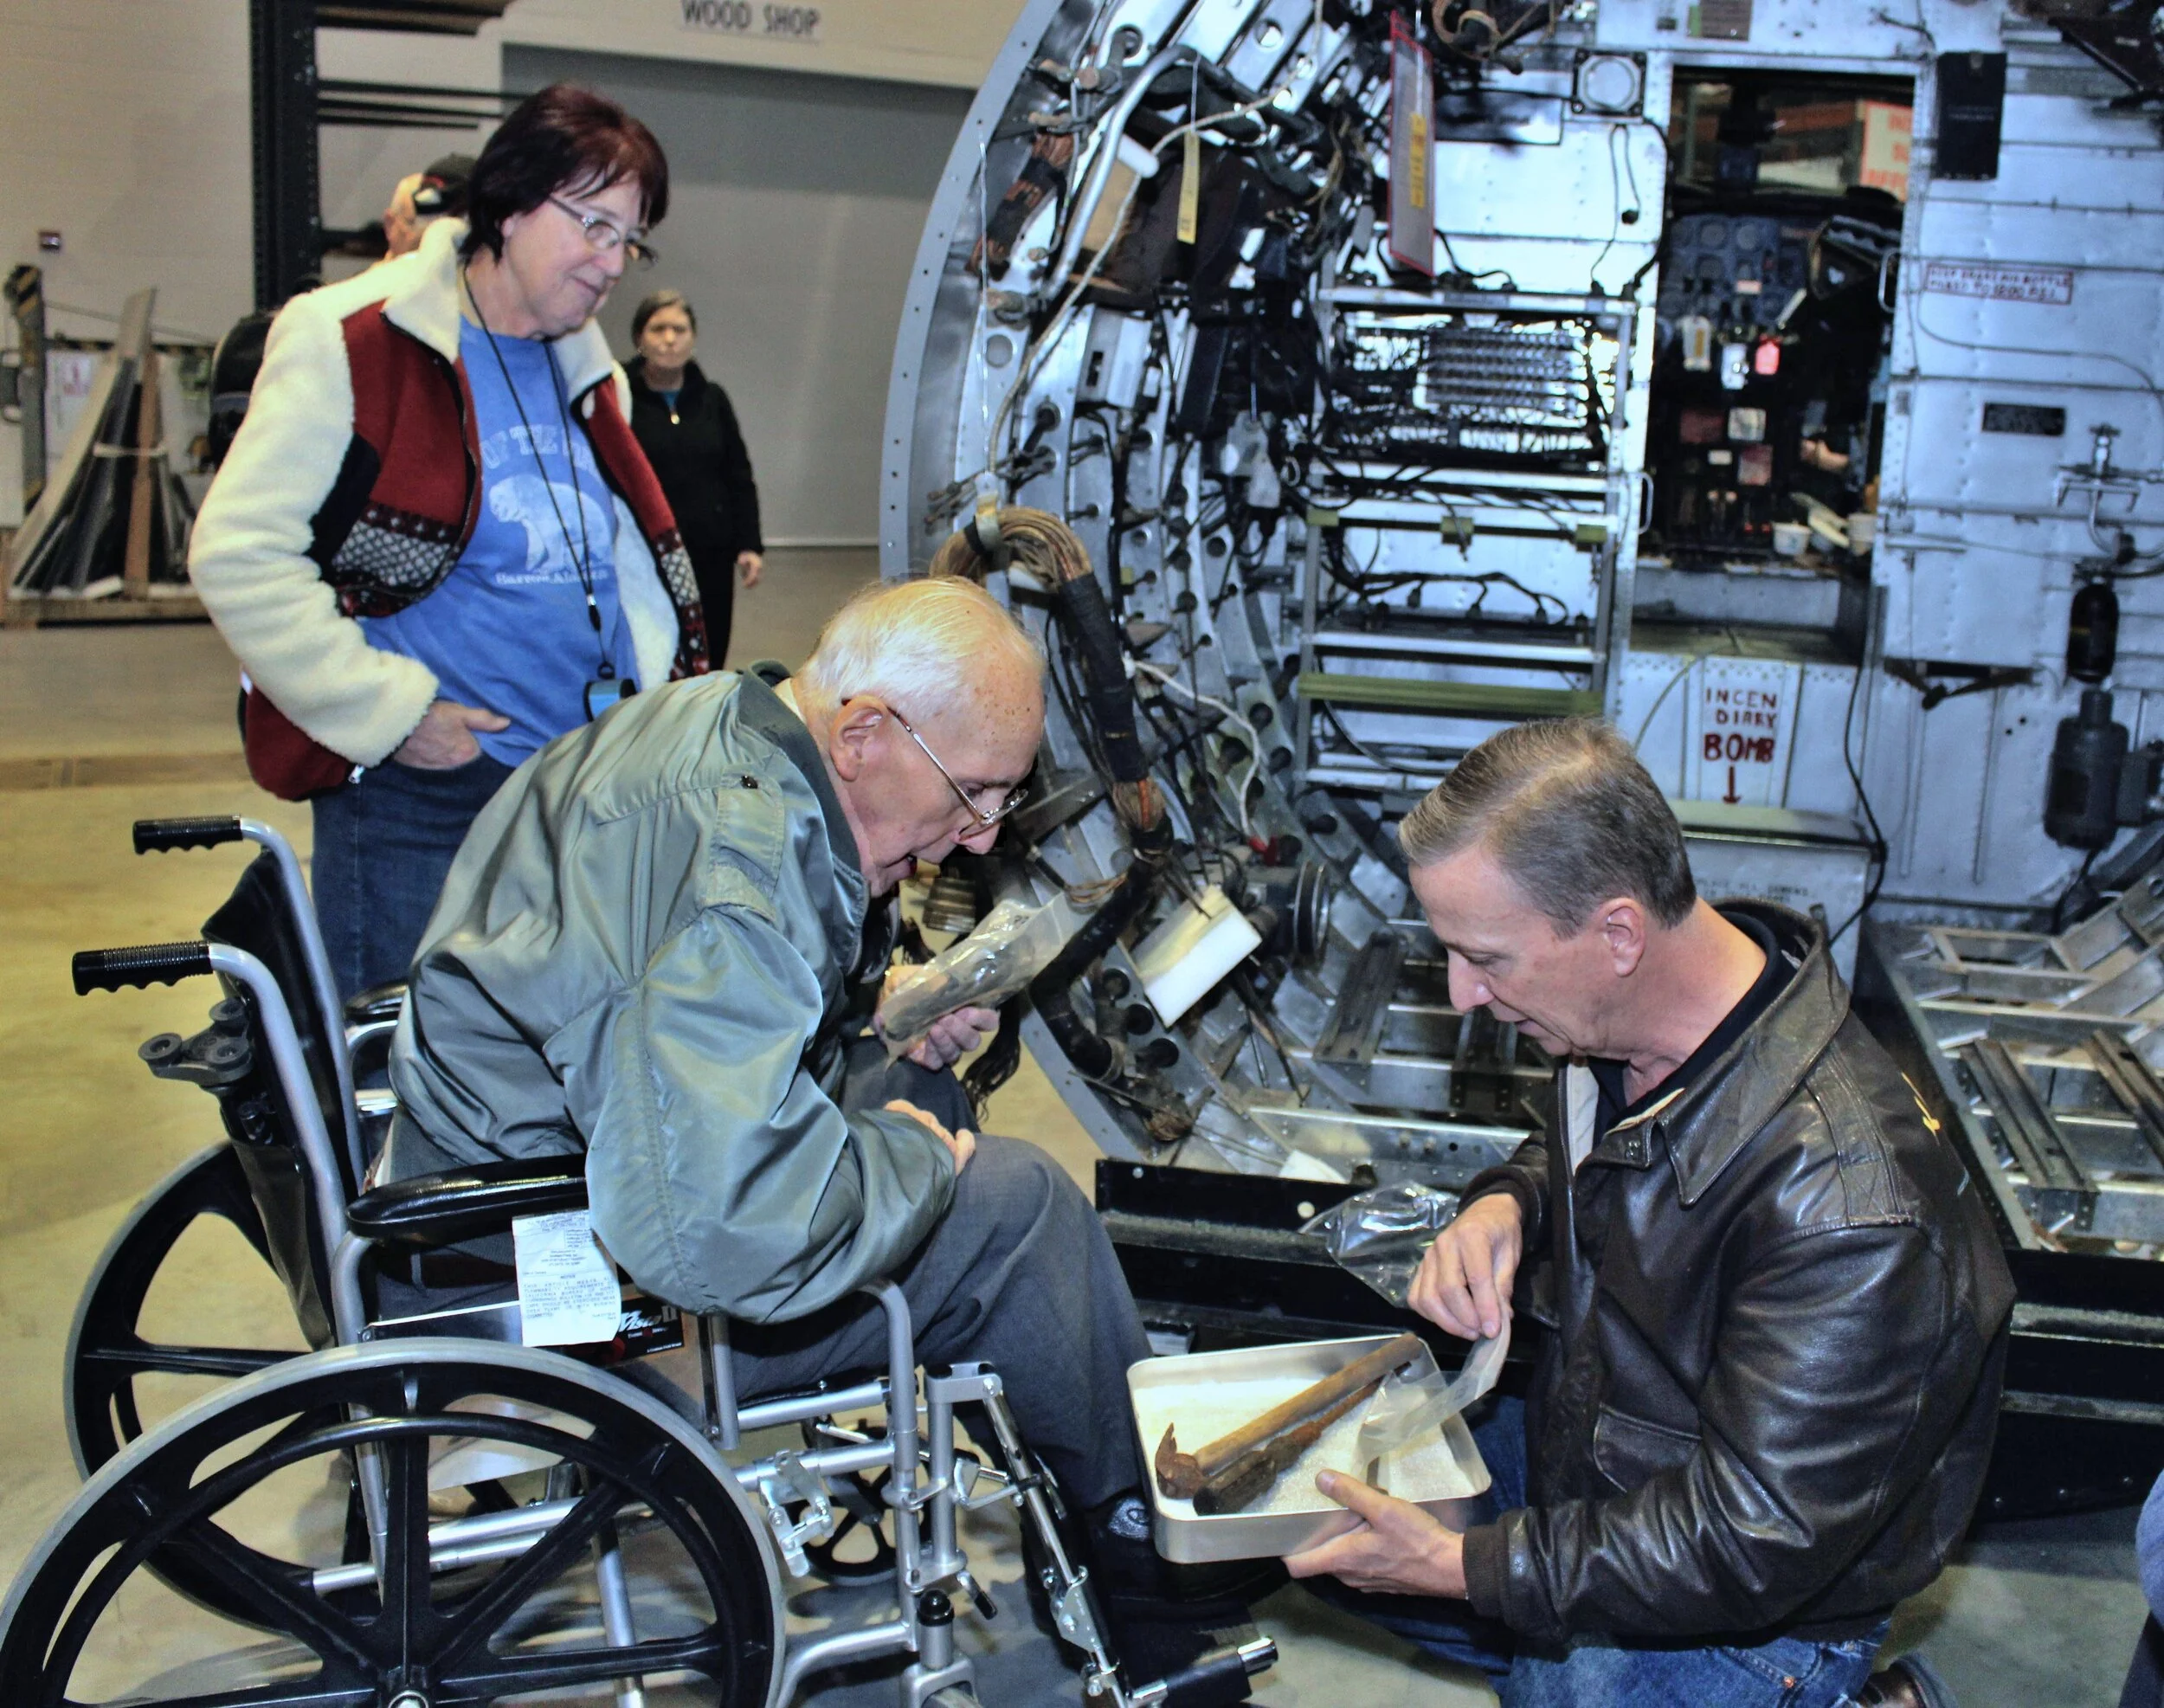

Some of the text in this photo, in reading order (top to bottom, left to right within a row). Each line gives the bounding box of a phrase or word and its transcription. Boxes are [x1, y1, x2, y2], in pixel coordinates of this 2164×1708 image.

[682, 0, 821, 35] WOOD SHOP
[509, 425, 558, 455] THE
[1705, 687, 1777, 708] INCEN
[1716, 709, 1777, 728] DIARY
[1704, 732, 1774, 763] BOMB
